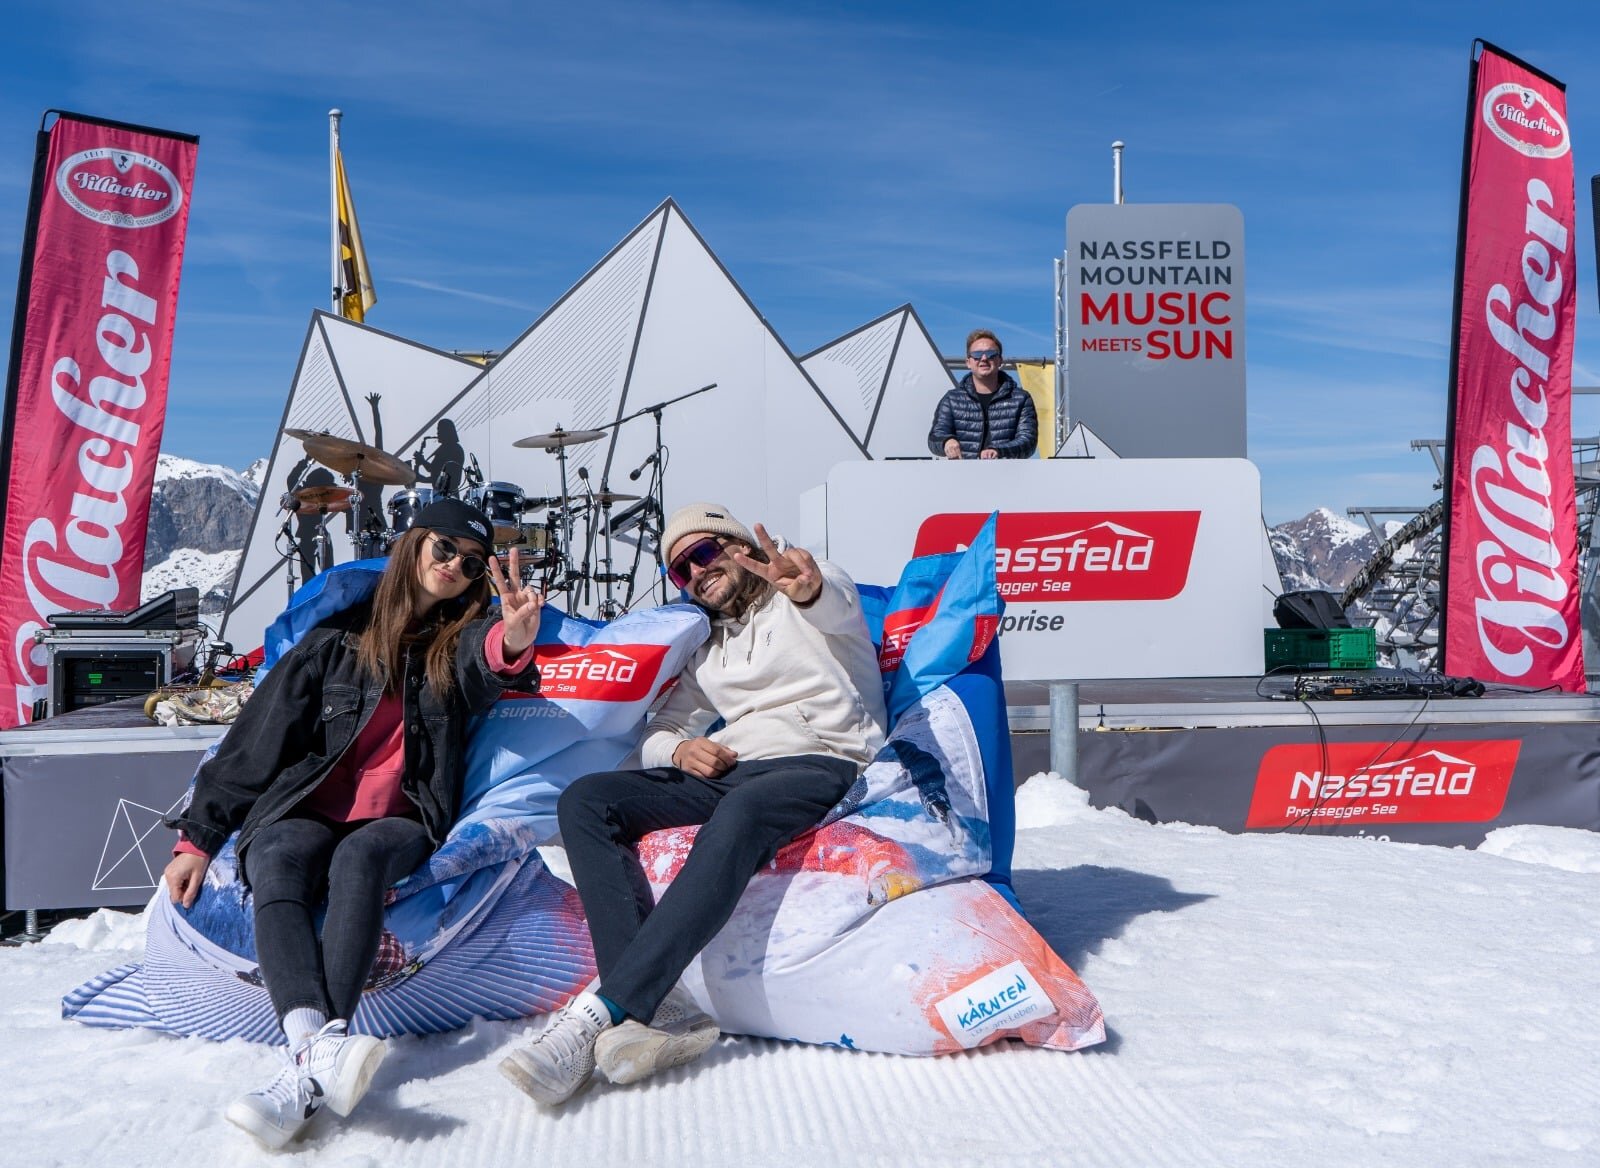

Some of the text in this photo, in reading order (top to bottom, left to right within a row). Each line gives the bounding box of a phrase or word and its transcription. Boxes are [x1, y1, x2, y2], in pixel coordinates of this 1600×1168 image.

[73, 172, 168, 201] Villacher
[1079, 241, 1231, 260] NASSFELD
[1080, 266, 1232, 285] MOUNTAIN
[1081, 292, 1231, 325] MUSIC
[1081, 329, 1233, 360] MEETS SUN
[1471, 178, 1569, 677] Villacher
[955, 538, 1154, 573] assfeld
[1041, 579, 1072, 592] See
[998, 609, 1065, 637] prise
[536, 658, 638, 684] ssfeld
[556, 683, 577, 693] See
[500, 703, 570, 721] surprise
[1289, 765, 1476, 800] Nassfeld
[1285, 803, 1399, 819] Pressegger See
